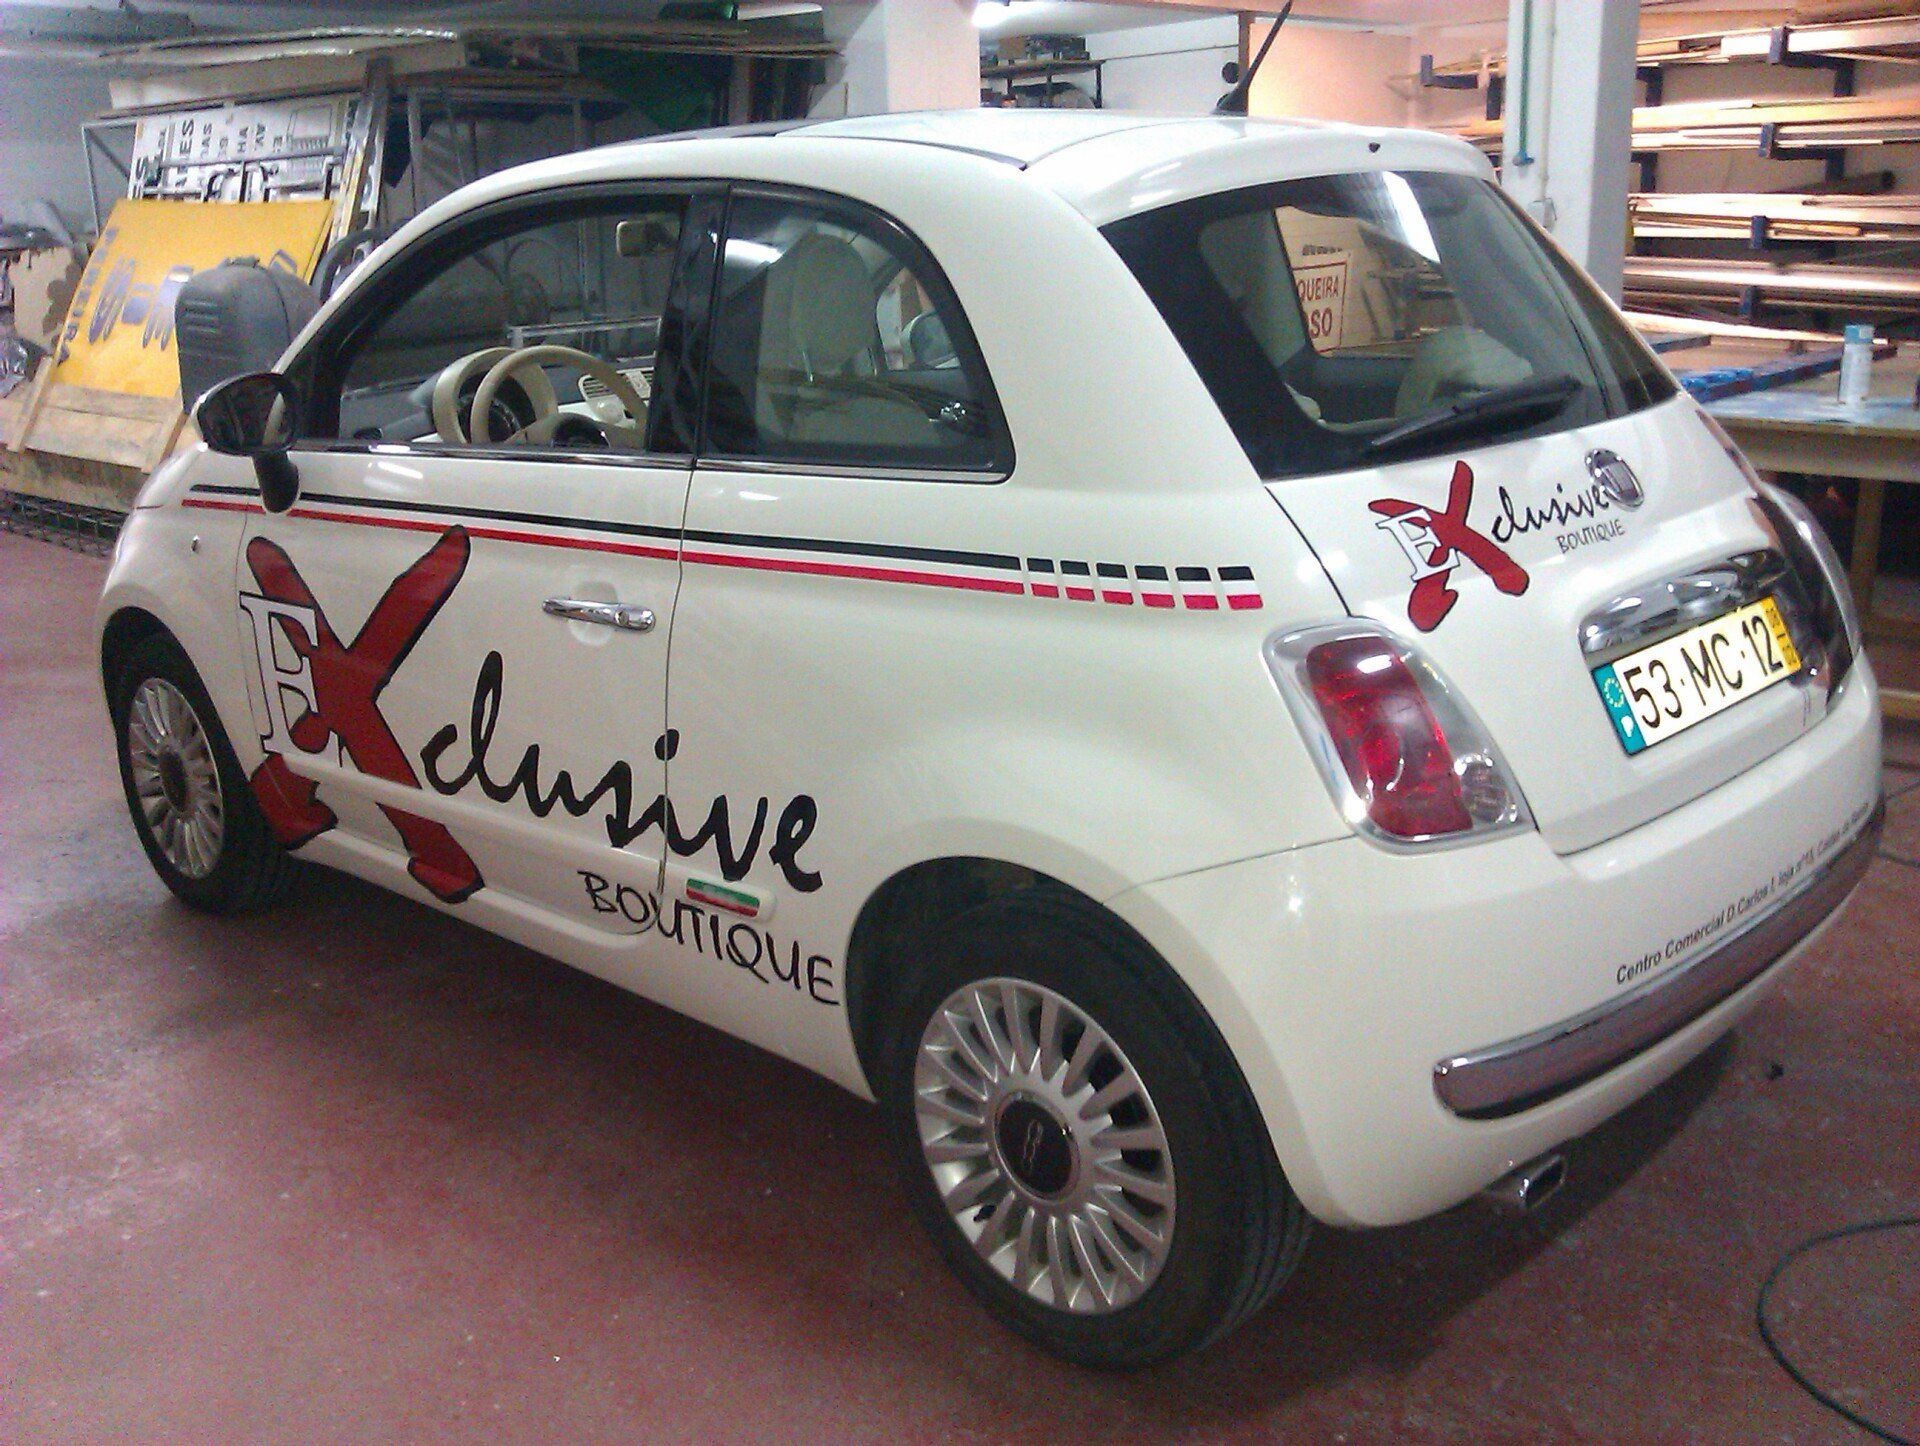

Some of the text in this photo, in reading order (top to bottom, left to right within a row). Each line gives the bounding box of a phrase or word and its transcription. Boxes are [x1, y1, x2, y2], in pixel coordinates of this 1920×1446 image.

[1556, 518, 1626, 554] BOUTIQUE
[577, 870, 840, 1006] BOUTIQUE
[1616, 951, 1662, 986] Centro
[1664, 912, 1725, 960] Comercial
